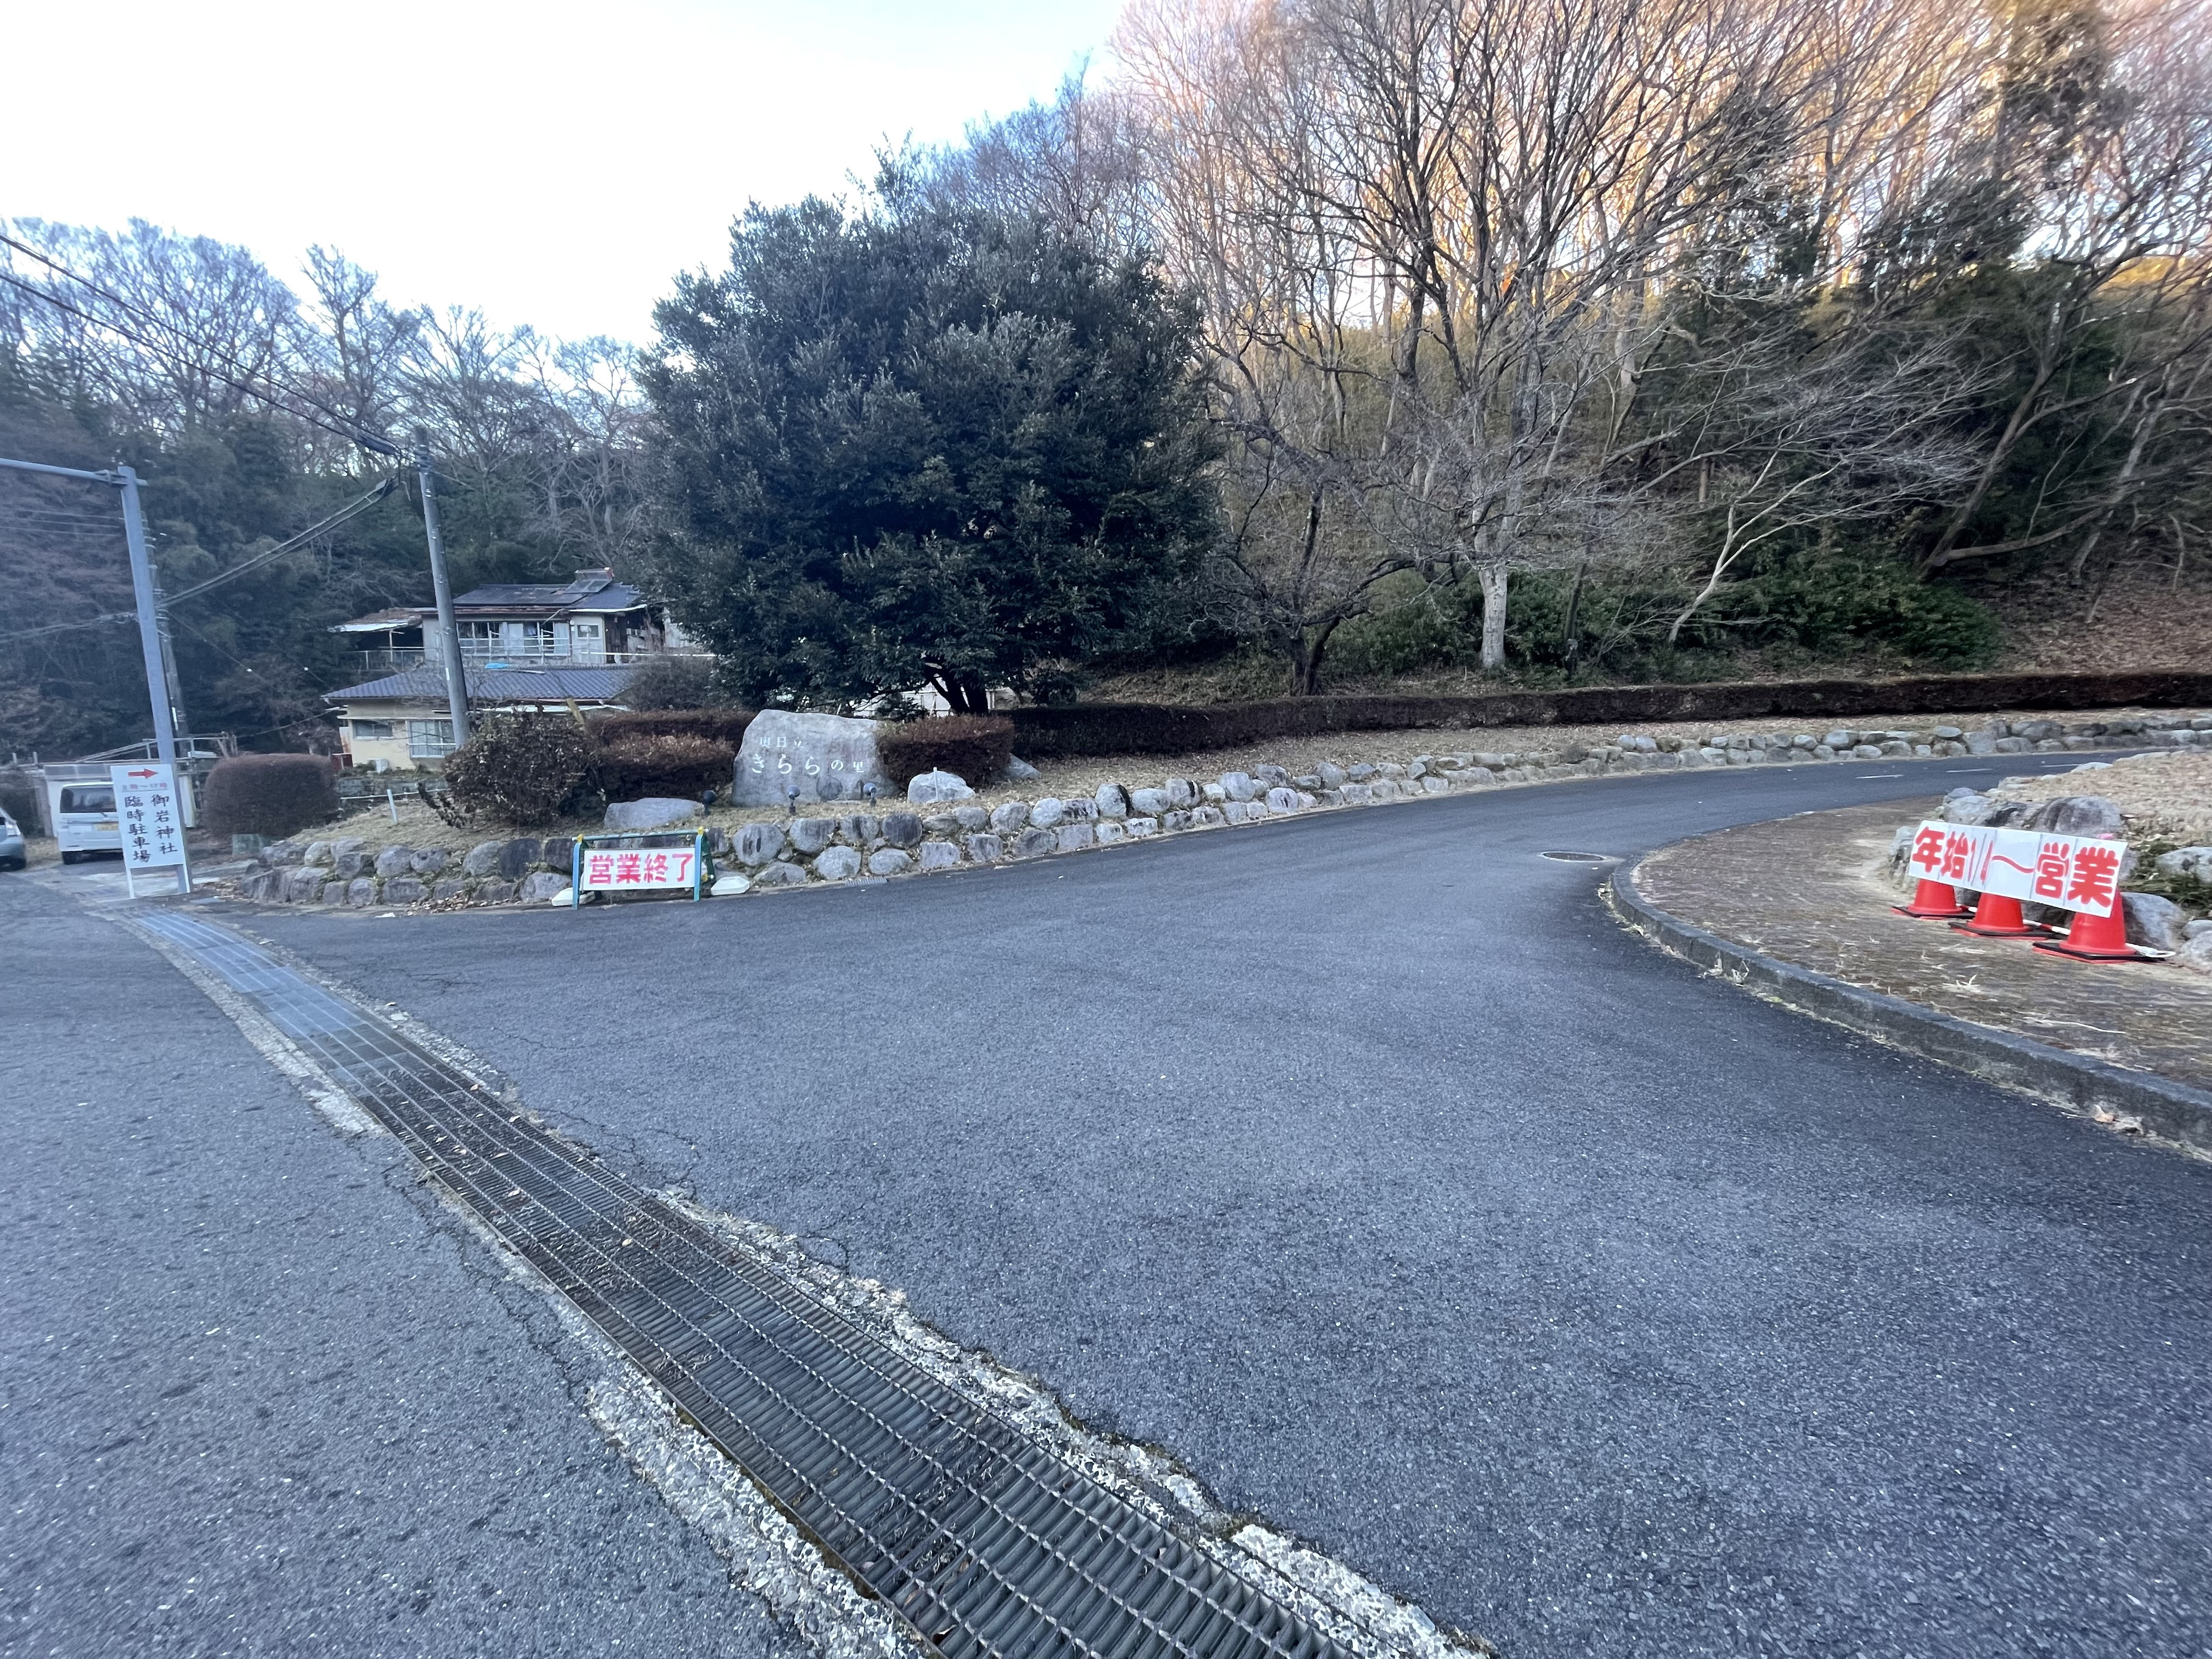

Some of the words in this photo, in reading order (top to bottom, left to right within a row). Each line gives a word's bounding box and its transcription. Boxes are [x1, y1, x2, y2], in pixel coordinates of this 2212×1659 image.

[752, 753, 865, 775] きららの里
[124, 795, 151, 863] 臨時駐車場
[150, 793, 178, 855] 御岩神社
[588, 853, 694, 885] 営業終了
